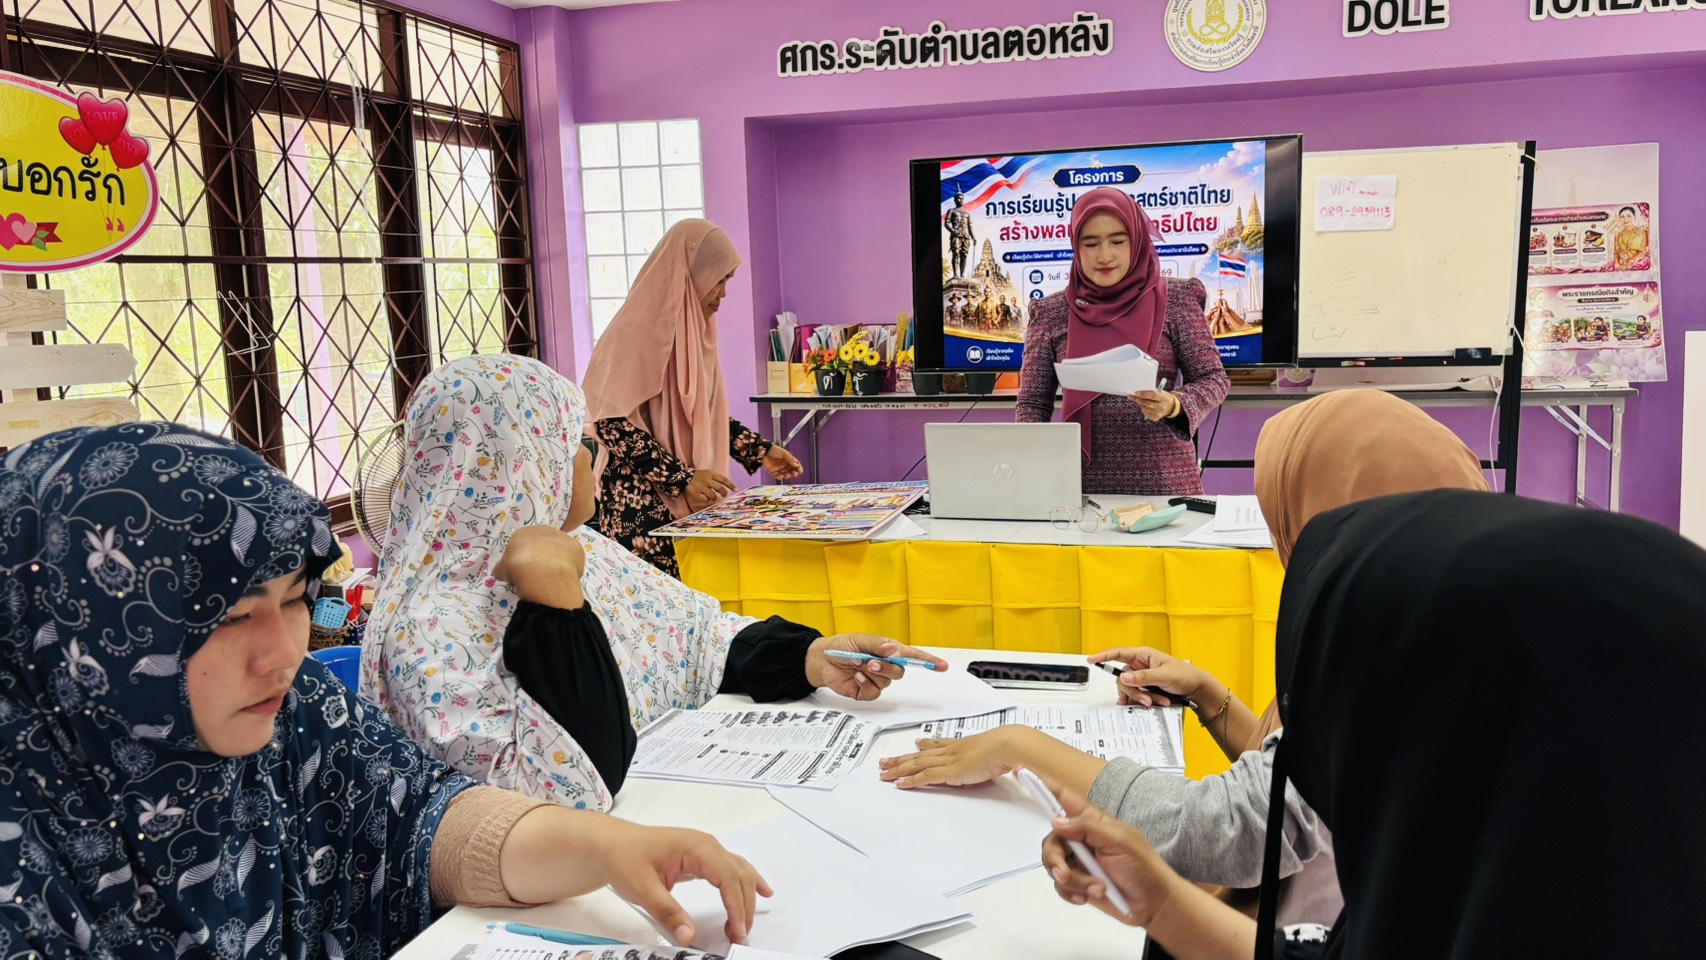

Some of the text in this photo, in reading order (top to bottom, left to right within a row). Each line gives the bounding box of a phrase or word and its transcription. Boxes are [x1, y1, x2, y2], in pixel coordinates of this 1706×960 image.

[1348, 0, 1445, 33] DOLE
[779, 14, 1109, 74] ศกร.ระดับตำบลตอหลัง
[1069, 169, 1124, 185] โครงการ
[1047, 271, 1061, 281] วันที่
